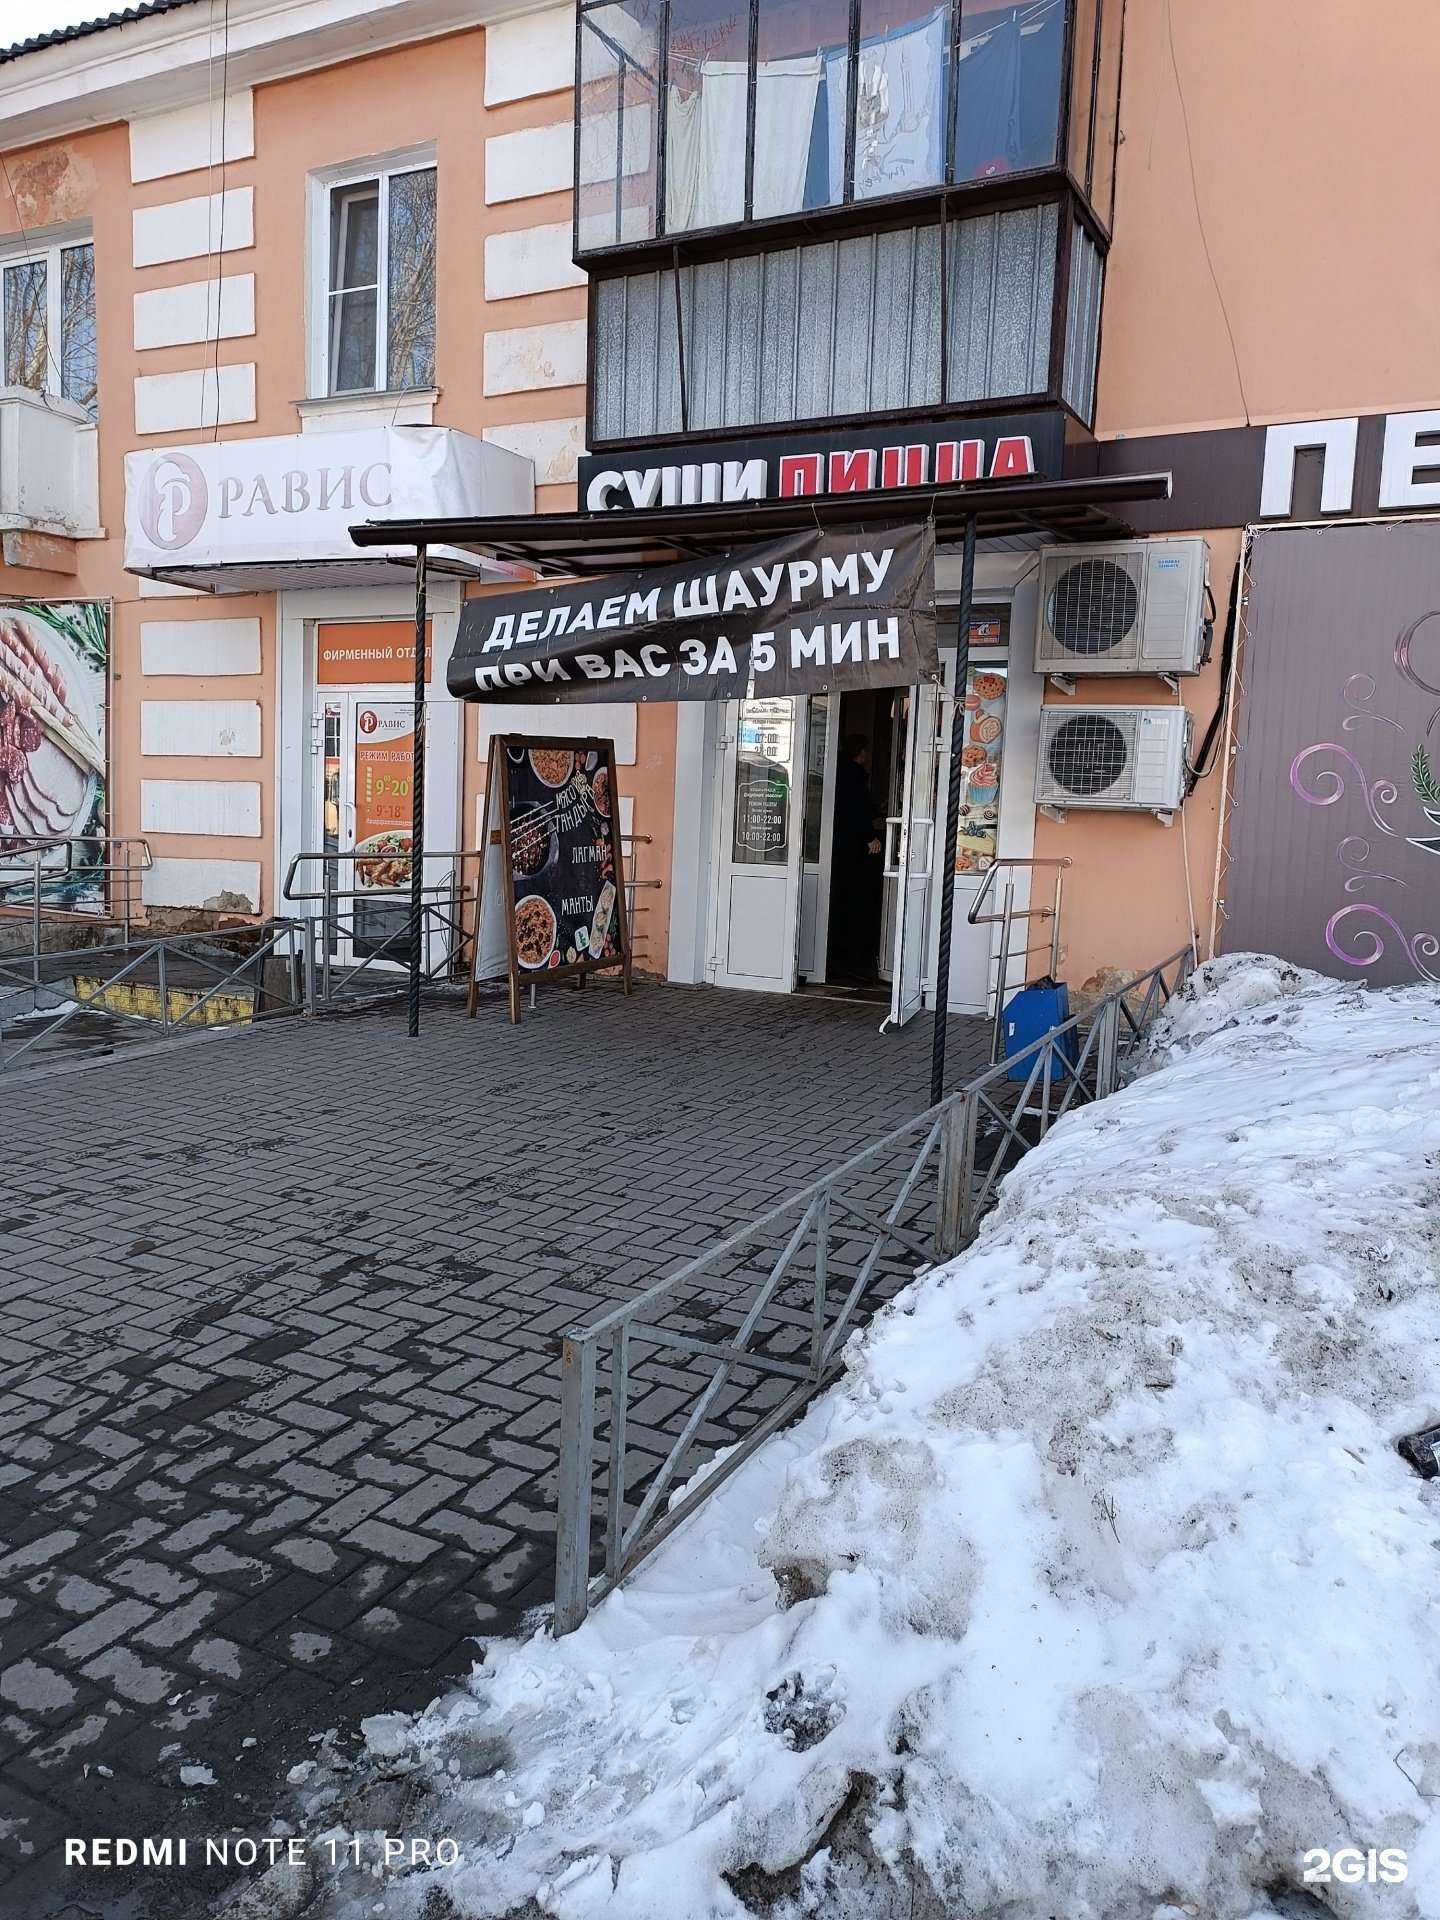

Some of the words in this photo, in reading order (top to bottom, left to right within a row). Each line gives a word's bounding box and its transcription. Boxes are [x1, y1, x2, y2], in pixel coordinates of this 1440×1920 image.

[217, 462, 392, 518] РАВИС
[587, 459, 768, 511] СУШИ
[779, 436, 1036, 498] ПИЦЦА
[482, 587, 661, 653] ДЕЛАЕМ
[673, 548, 894, 617] ШАУРМУ
[323, 646, 393, 660] ФИРМЕННЫЙ
[396, 646, 432, 658] ОТДЛ
[475, 659, 571, 691] ПРИ
[575, 644, 669, 679] ВАС
[680, 636, 738, 675] ЗА
[753, 631, 776, 671] 5
[791, 617, 900, 668] МИН
[360, 751, 388, 761] РЕЖИМ
[391, 752, 414, 761] РАБОТ
[555, 783, 596, 833] ТАНДЫРА
[571, 845, 607, 864] ЛАГМАН
[561, 896, 594, 916] МАНТЫ
